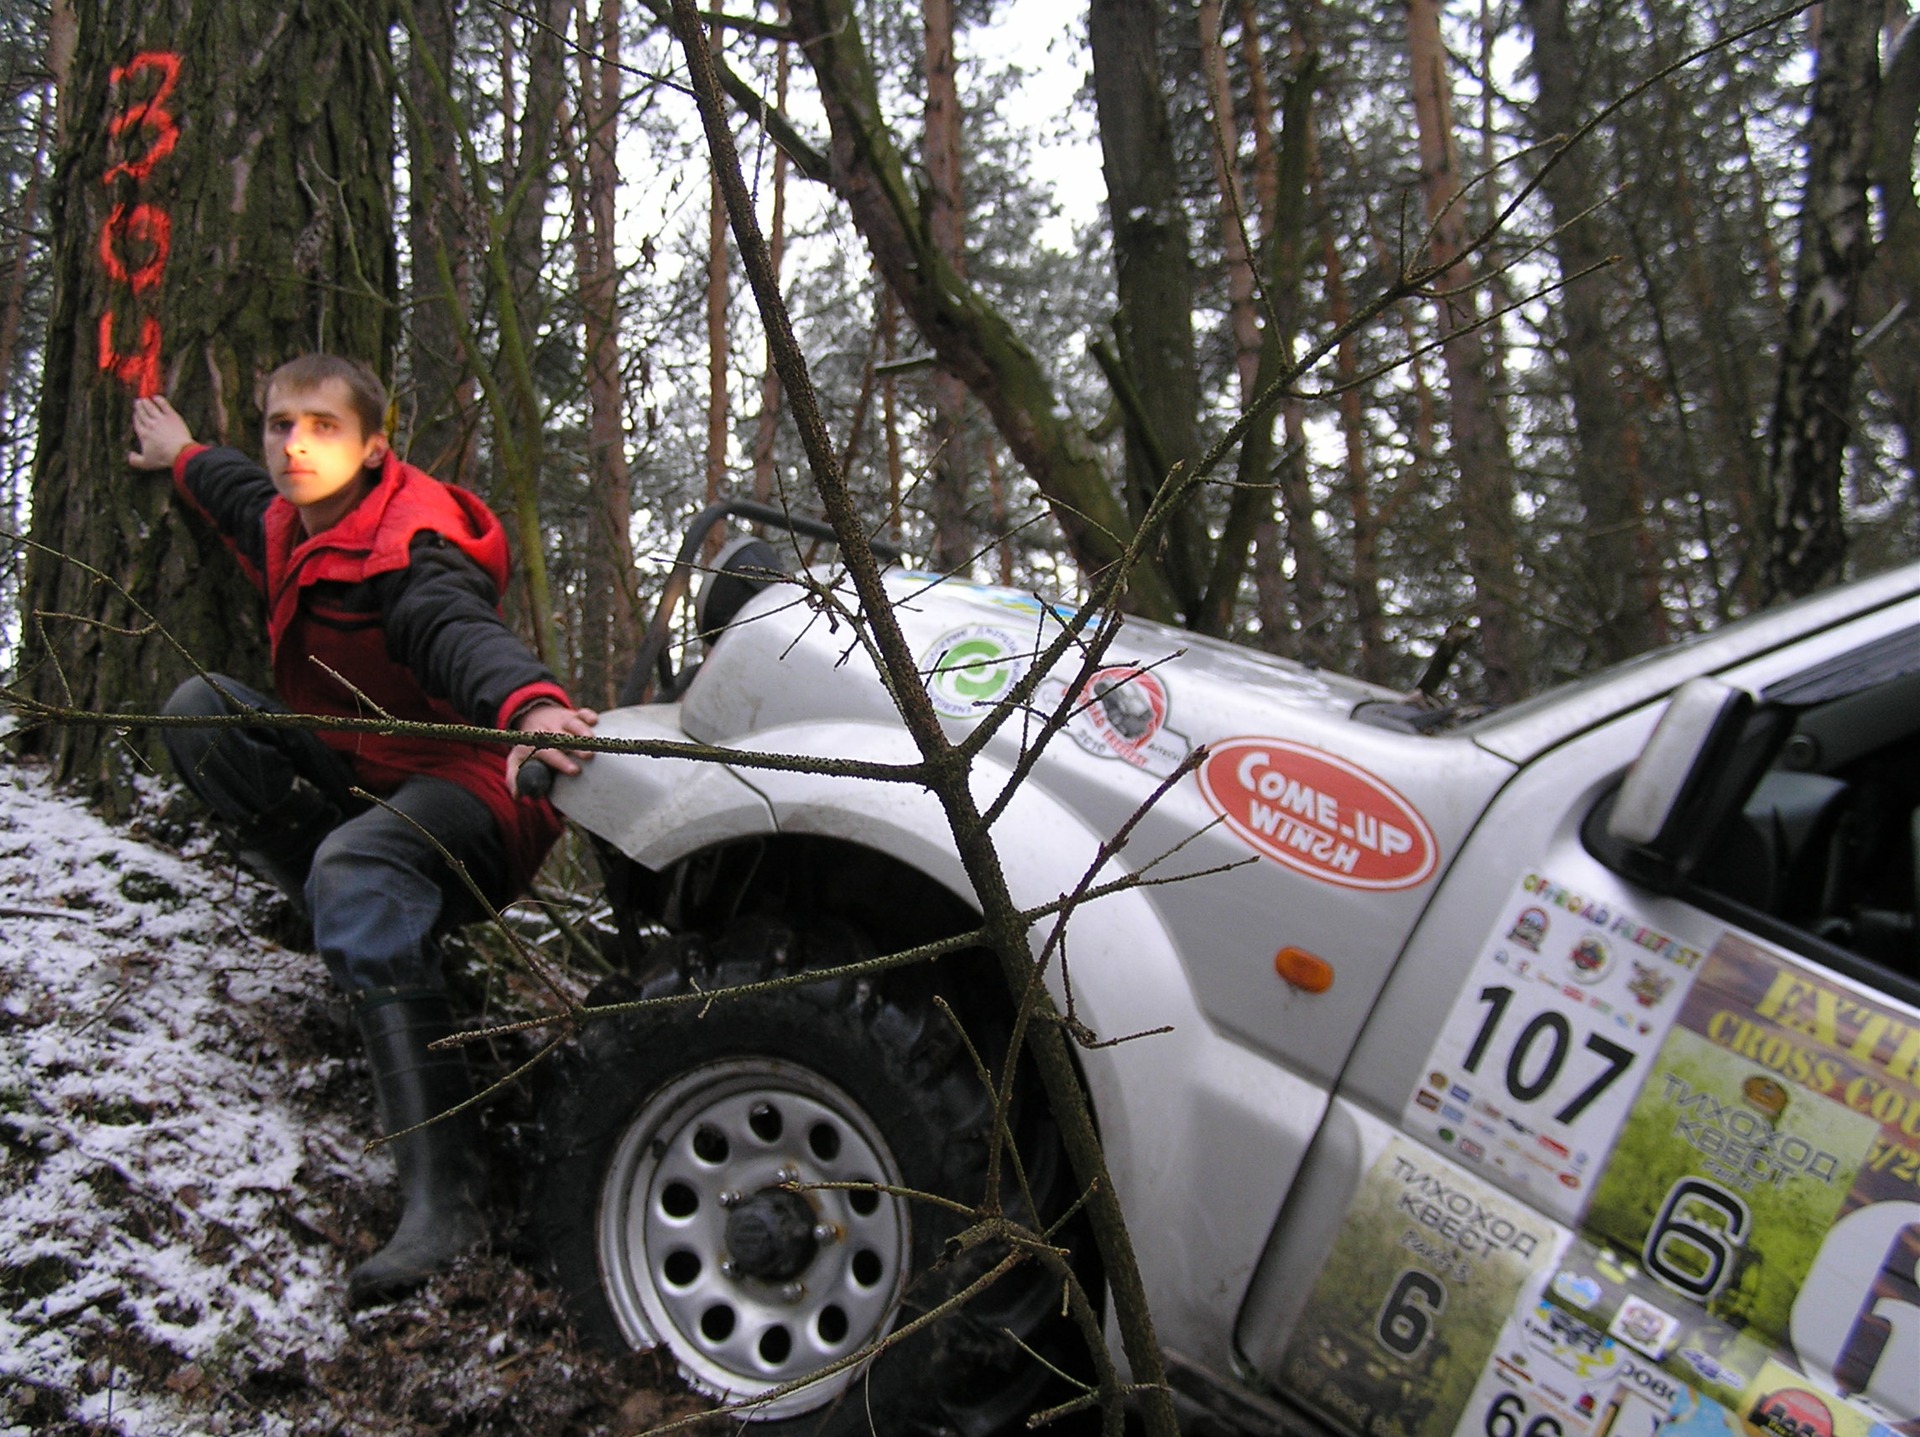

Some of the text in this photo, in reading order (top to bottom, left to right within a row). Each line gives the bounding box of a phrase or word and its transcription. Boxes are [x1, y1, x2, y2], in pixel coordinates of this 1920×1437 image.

[1463, 985, 1636, 1126] 107
[1707, 1009, 1843, 1093] CROSS
[1663, 1072, 1839, 1186] ТИХОХОД
[1672, 1114, 1797, 1191] КВЕСТ
[1391, 1156, 1538, 1260] ТИХОХОД
[1398, 1191, 1499, 1260] КВЕСТ
[1643, 1176, 1751, 1303] 6
[1375, 1267, 1447, 1360] 6
